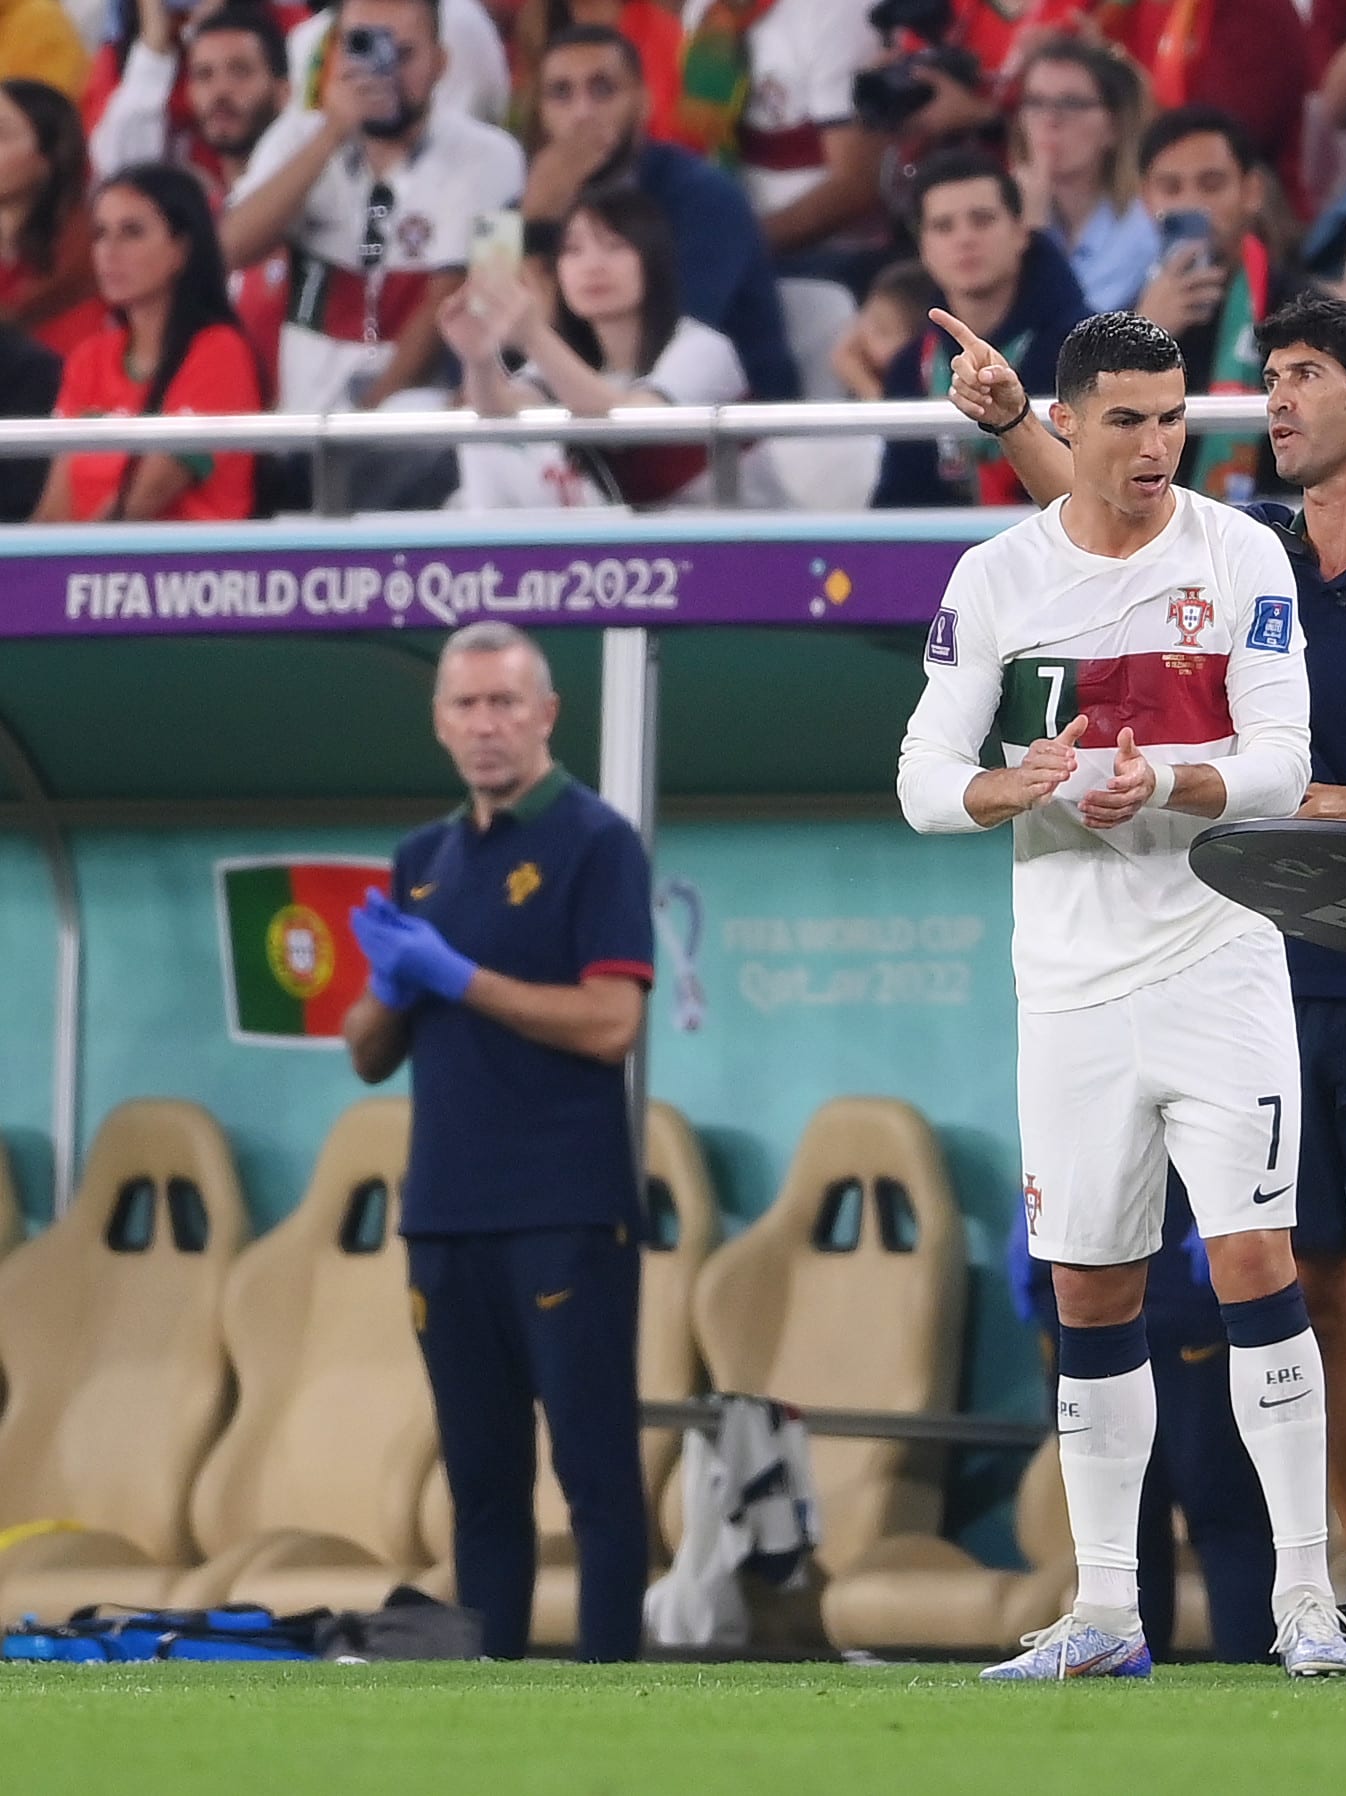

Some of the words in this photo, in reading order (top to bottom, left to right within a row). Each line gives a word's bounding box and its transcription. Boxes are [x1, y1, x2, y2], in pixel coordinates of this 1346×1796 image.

[66, 572, 152, 619] FIFA
[154, 569, 300, 618] WORLD
[302, 566, 383, 615] CUP
[566, 558, 679, 610] 2022
[1038, 666, 1065, 738] 7
[1256, 1094, 1282, 1171] 7
